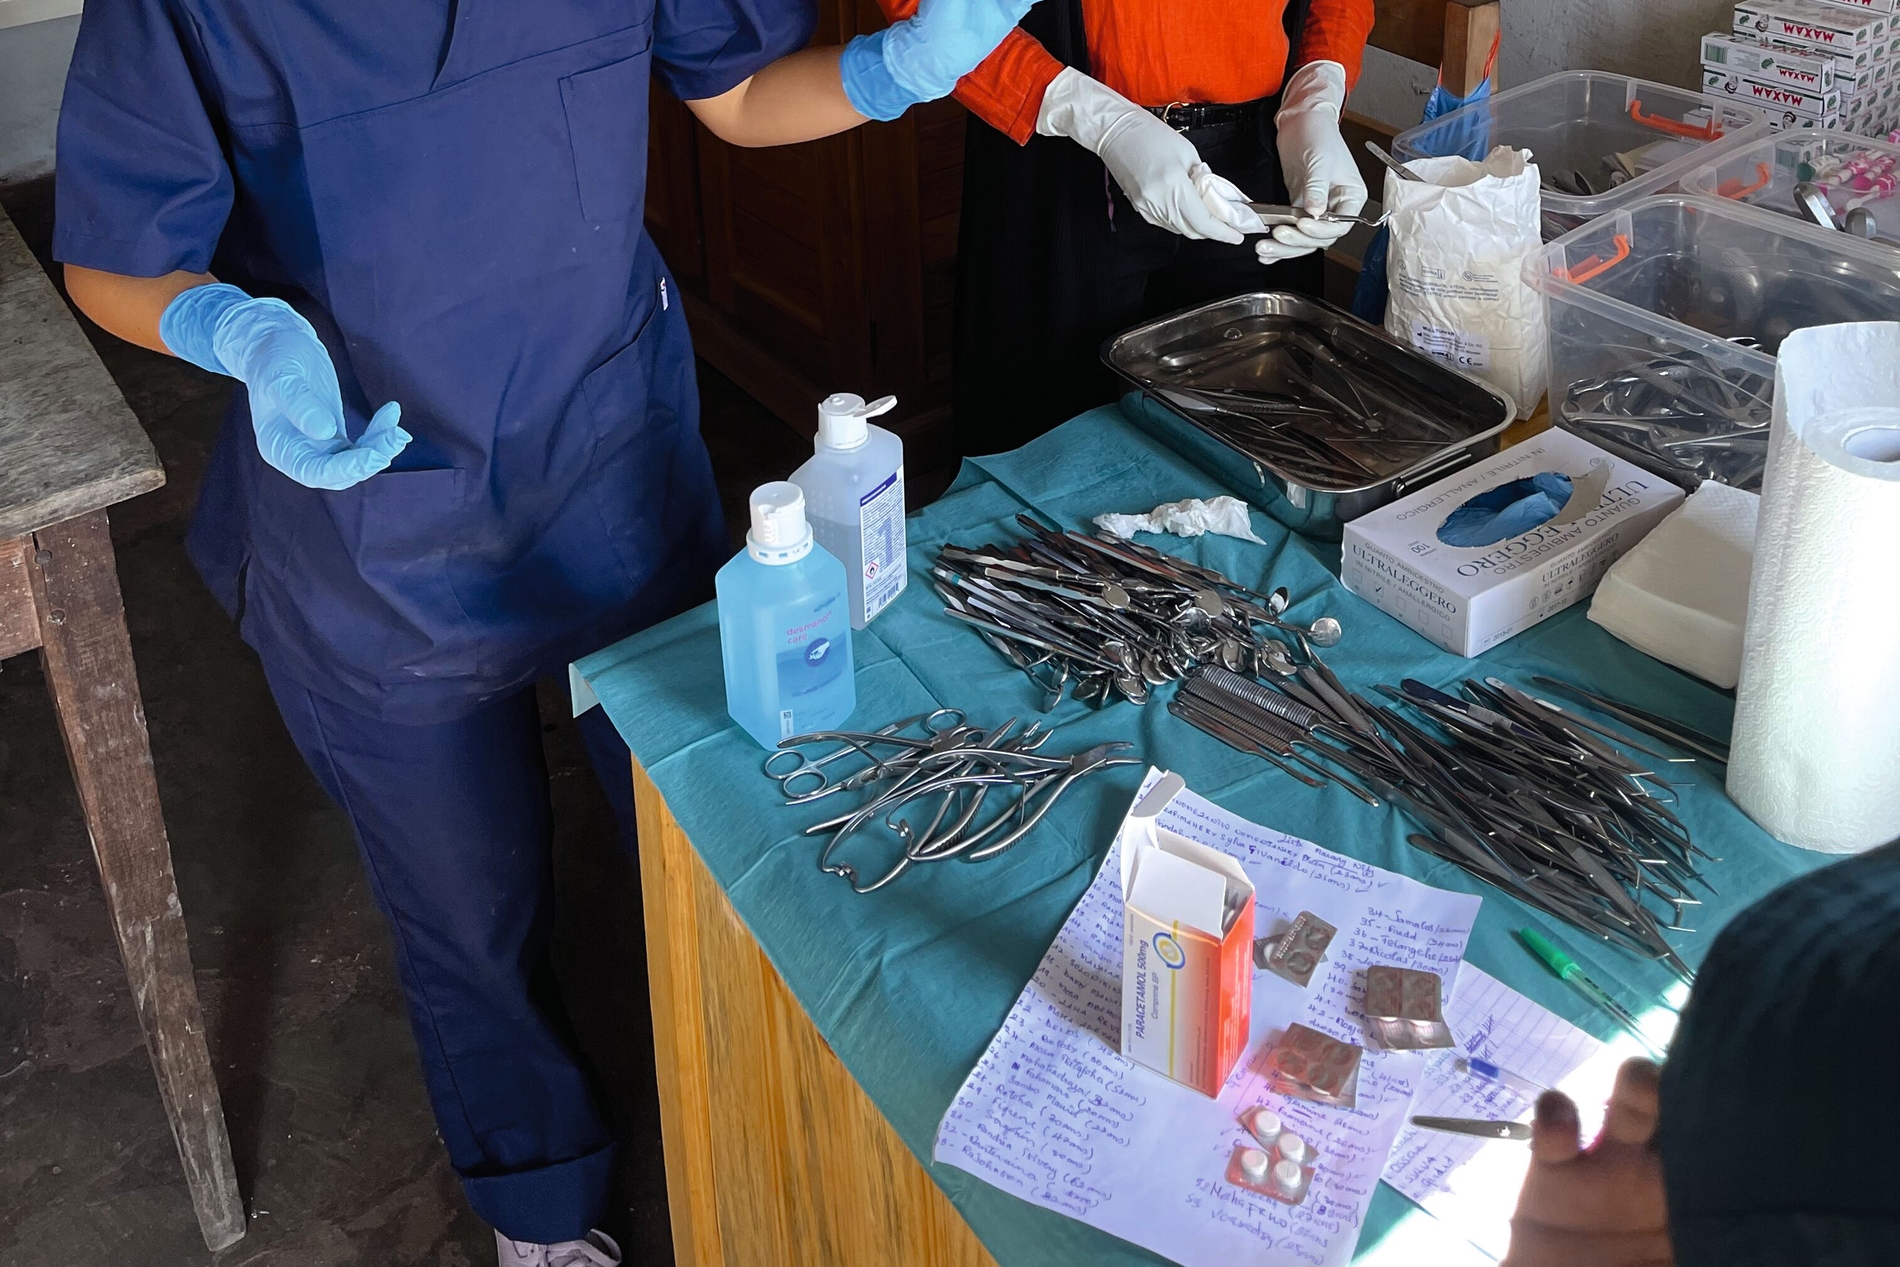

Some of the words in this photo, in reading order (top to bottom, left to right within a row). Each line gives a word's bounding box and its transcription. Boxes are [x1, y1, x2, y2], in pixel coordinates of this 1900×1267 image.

[1783, 22, 1835, 43] MAXAM
[1779, 69, 1815, 83] MAXAM
[1752, 85, 1803, 106] MAXAM
[1488, 453, 1529, 477] NITRILE
[1530, 447, 1546, 459] IN
[1396, 476, 1479, 521] ANALLERGICO
[1584, 497, 1641, 528] GUANTO
[1493, 525, 1582, 576] AMBIDESTRO
[1542, 532, 1620, 583] ULTRALEGGERO
[1352, 544, 1457, 615] ULTRALEGGERO
[1364, 541, 1396, 564] GUANTO
[1395, 560, 1446, 594] AMBIDESTRO
[788, 632, 808, 645] care
[1140, 939, 1149, 970] 500mg
[1136, 973, 1148, 1039] PARACETAMOL
